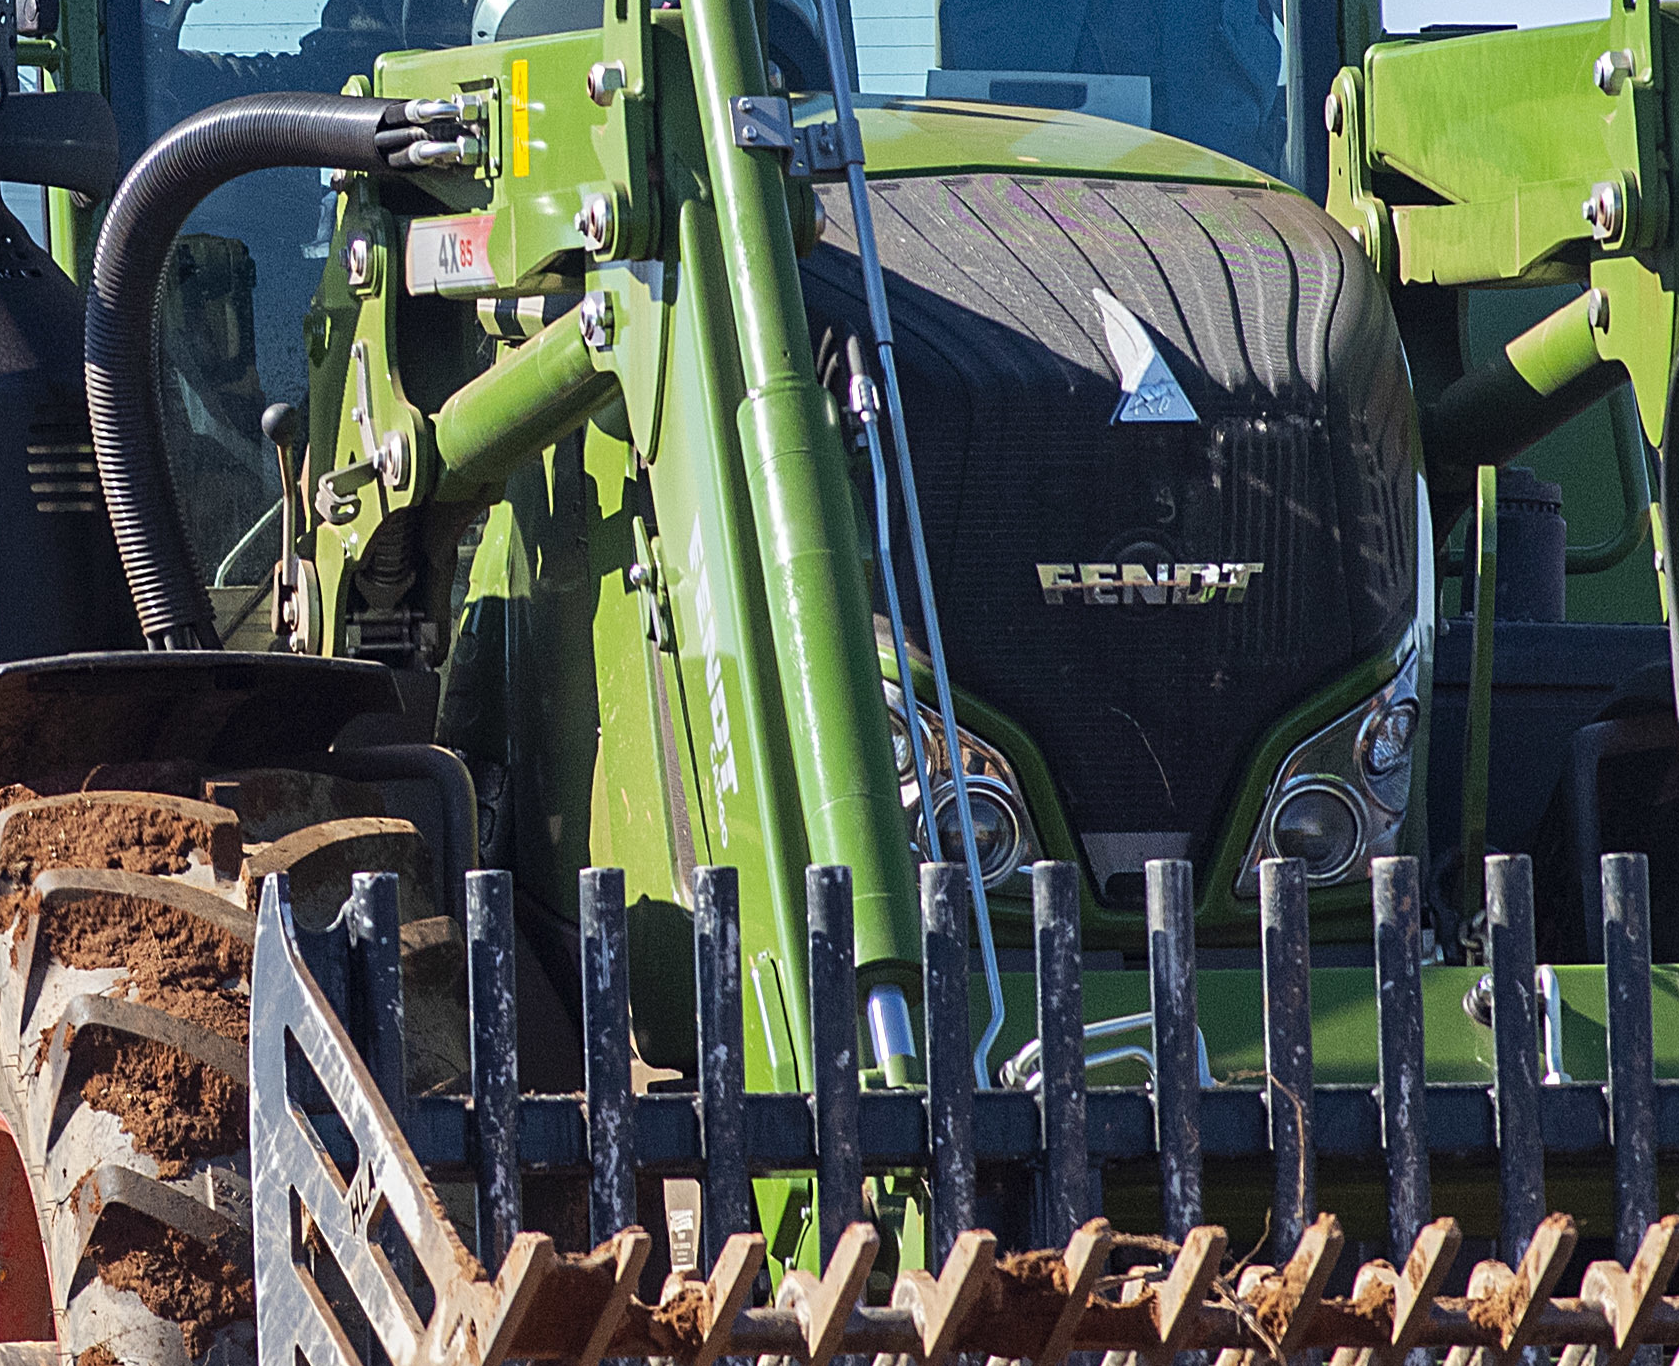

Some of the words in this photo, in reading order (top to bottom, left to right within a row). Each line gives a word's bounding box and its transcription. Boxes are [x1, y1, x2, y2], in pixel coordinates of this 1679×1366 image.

[1036, 563, 1265, 605] FENDT
[687, 511, 739, 795] FENDT
[710, 741, 730, 850] CARGO
[349, 1158, 377, 1236] HLA
